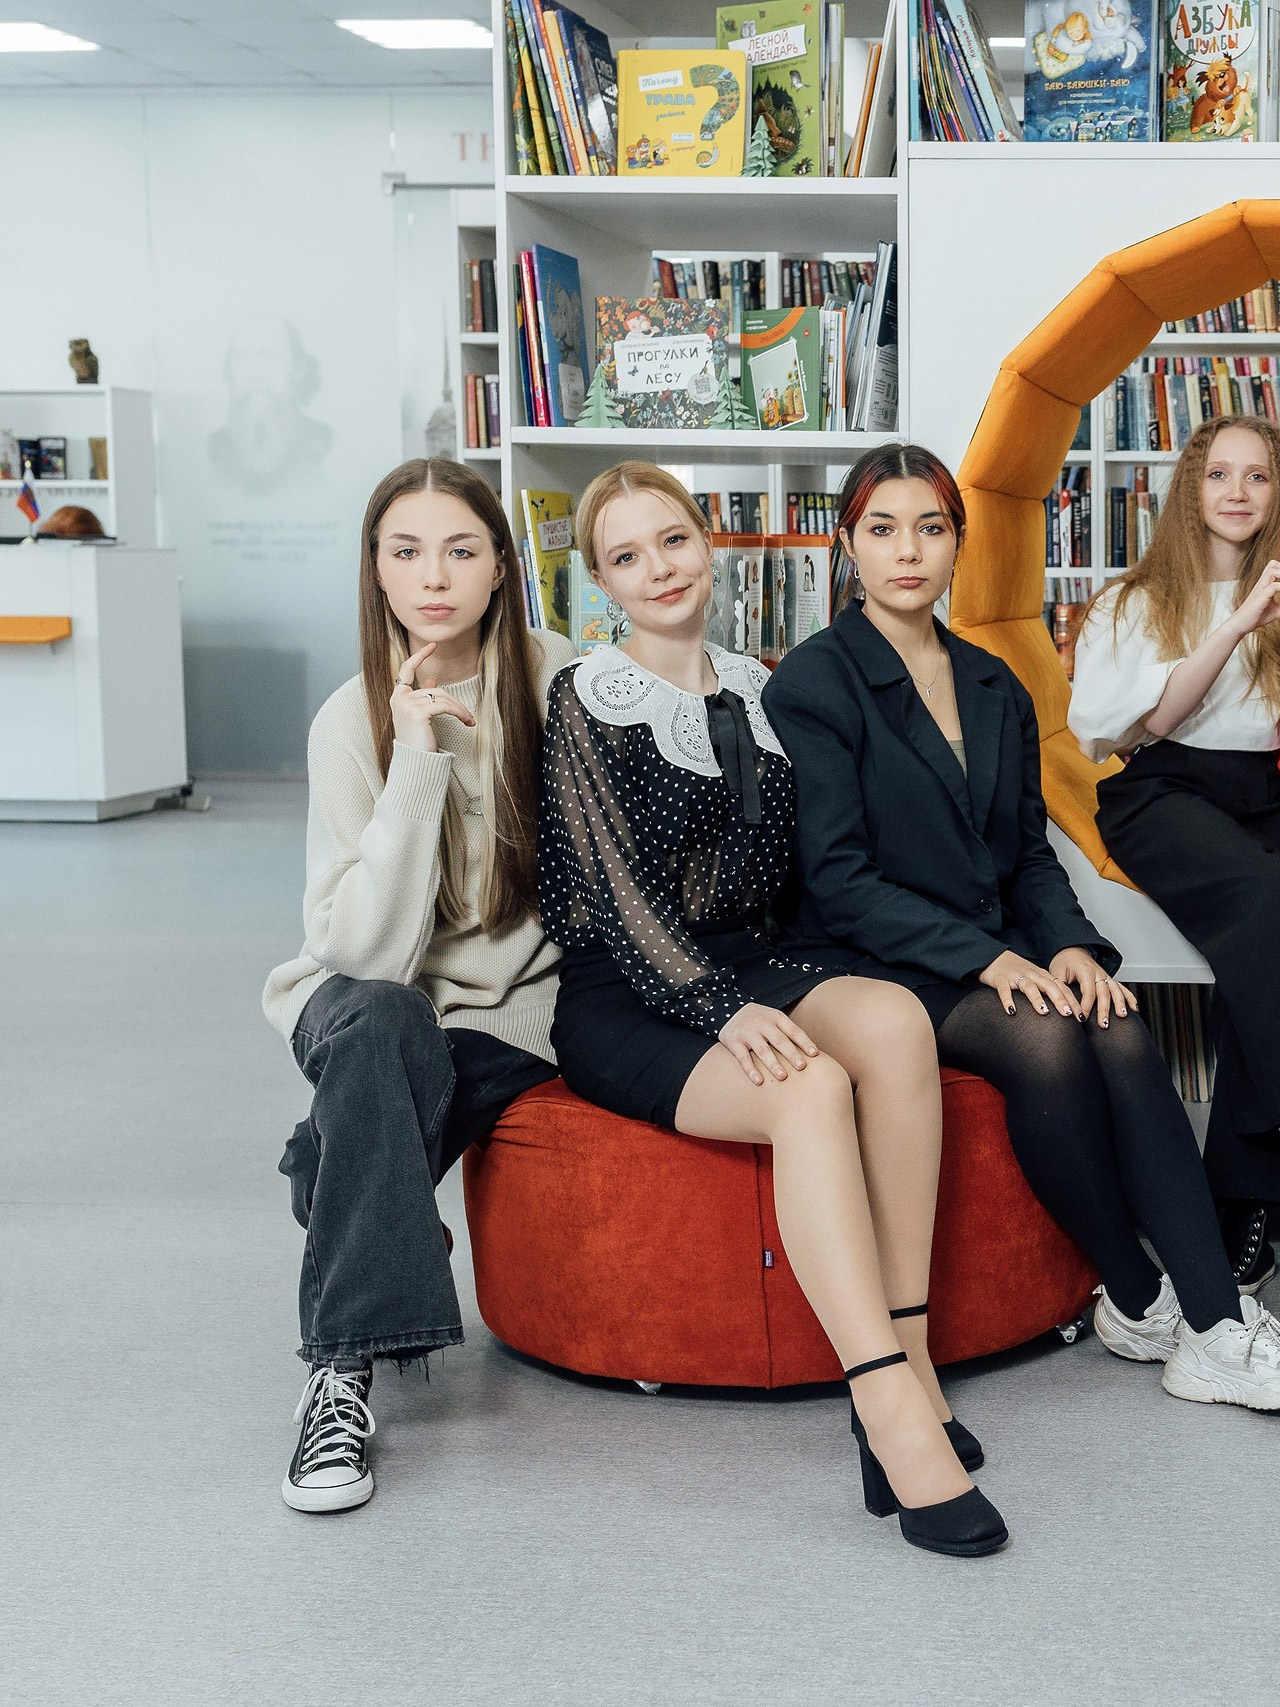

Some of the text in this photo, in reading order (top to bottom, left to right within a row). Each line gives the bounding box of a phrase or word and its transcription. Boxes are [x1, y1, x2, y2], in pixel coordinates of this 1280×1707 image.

[1174, 0, 1252, 40] АЗБУКА
[748, 30, 788, 50] ЛЕСНОЙ
[1186, 33, 1239, 55] ДРУЖБЫ
[746, 43, 798, 63] АЛЕНДАРЬ
[642, 76, 678, 87] Почему
[646, 94, 696, 105] ТРАВА
[628, 347, 699, 362] ПРОГУЛКИ
[646, 373, 681, 384] ЛЕСУ
